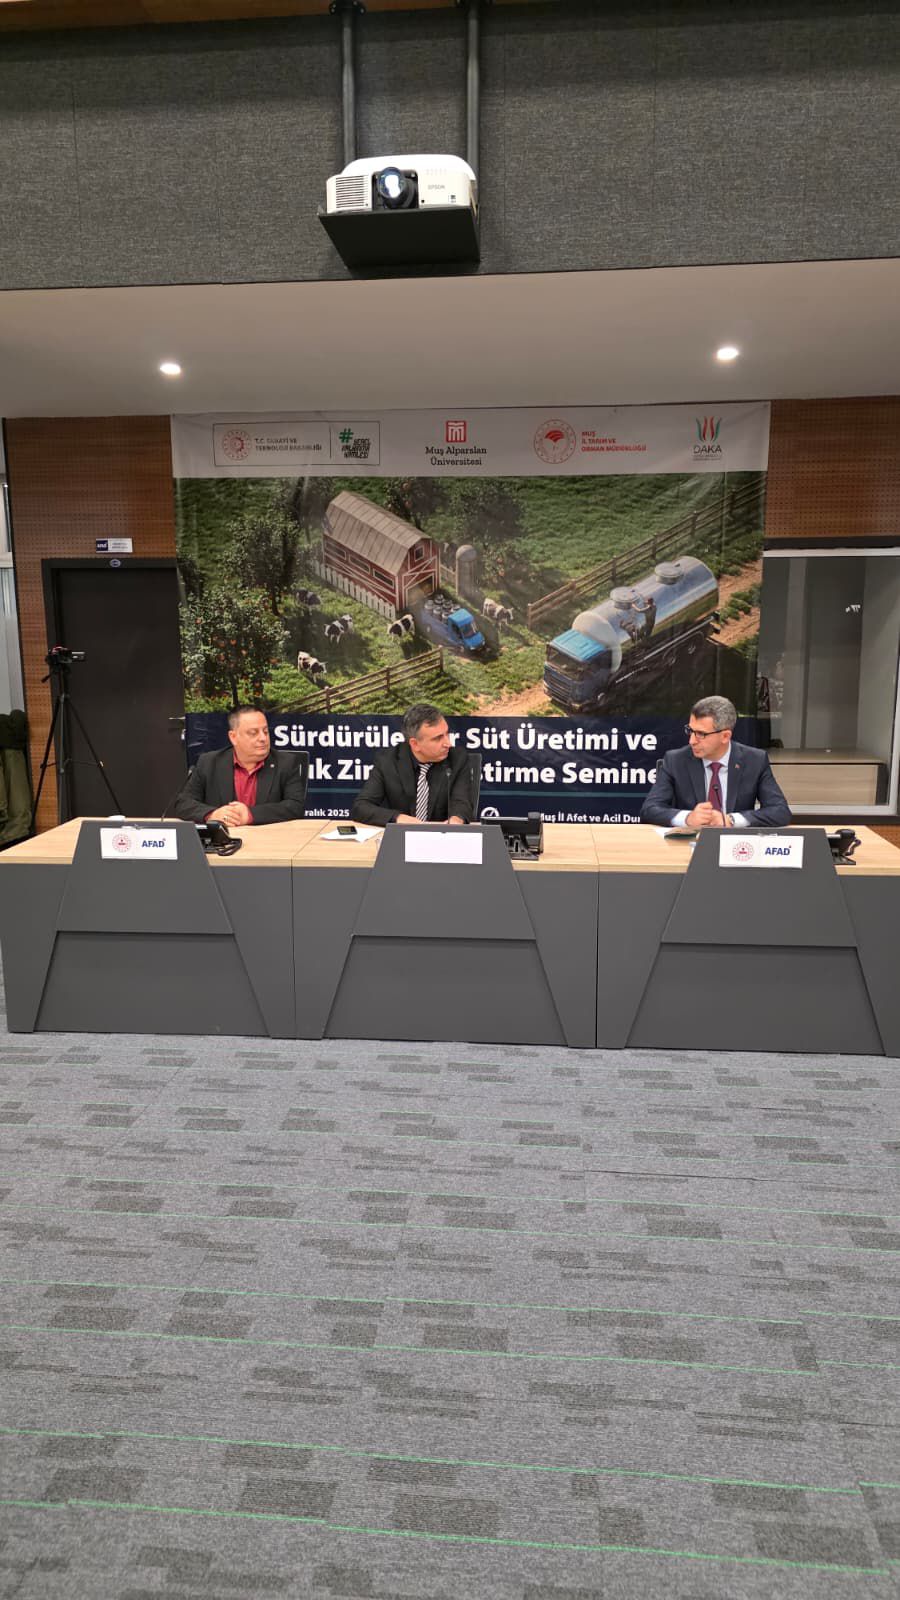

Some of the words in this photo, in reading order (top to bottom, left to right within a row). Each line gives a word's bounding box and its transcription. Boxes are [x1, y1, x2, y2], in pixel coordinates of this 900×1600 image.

[425, 447, 444, 456] Muş
[446, 446, 487, 456] Alparslan
[693, 445, 722, 454] DAKA
[430, 456, 482, 466] Üniversitesi
[466, 727, 510, 749] Süt
[517, 723, 618, 750] Üretimi
[625, 733, 658, 750] ve
[562, 762, 657, 784] Semine
[304, 808, 326, 817] ralık
[327, 809, 350, 817] 2025
[566, 813, 587, 822] Afet
[589, 814, 601, 823] ve
[602, 814, 621, 823] Acil
[141, 839, 165, 848] AFAD
[764, 847, 790, 856] AFAD
